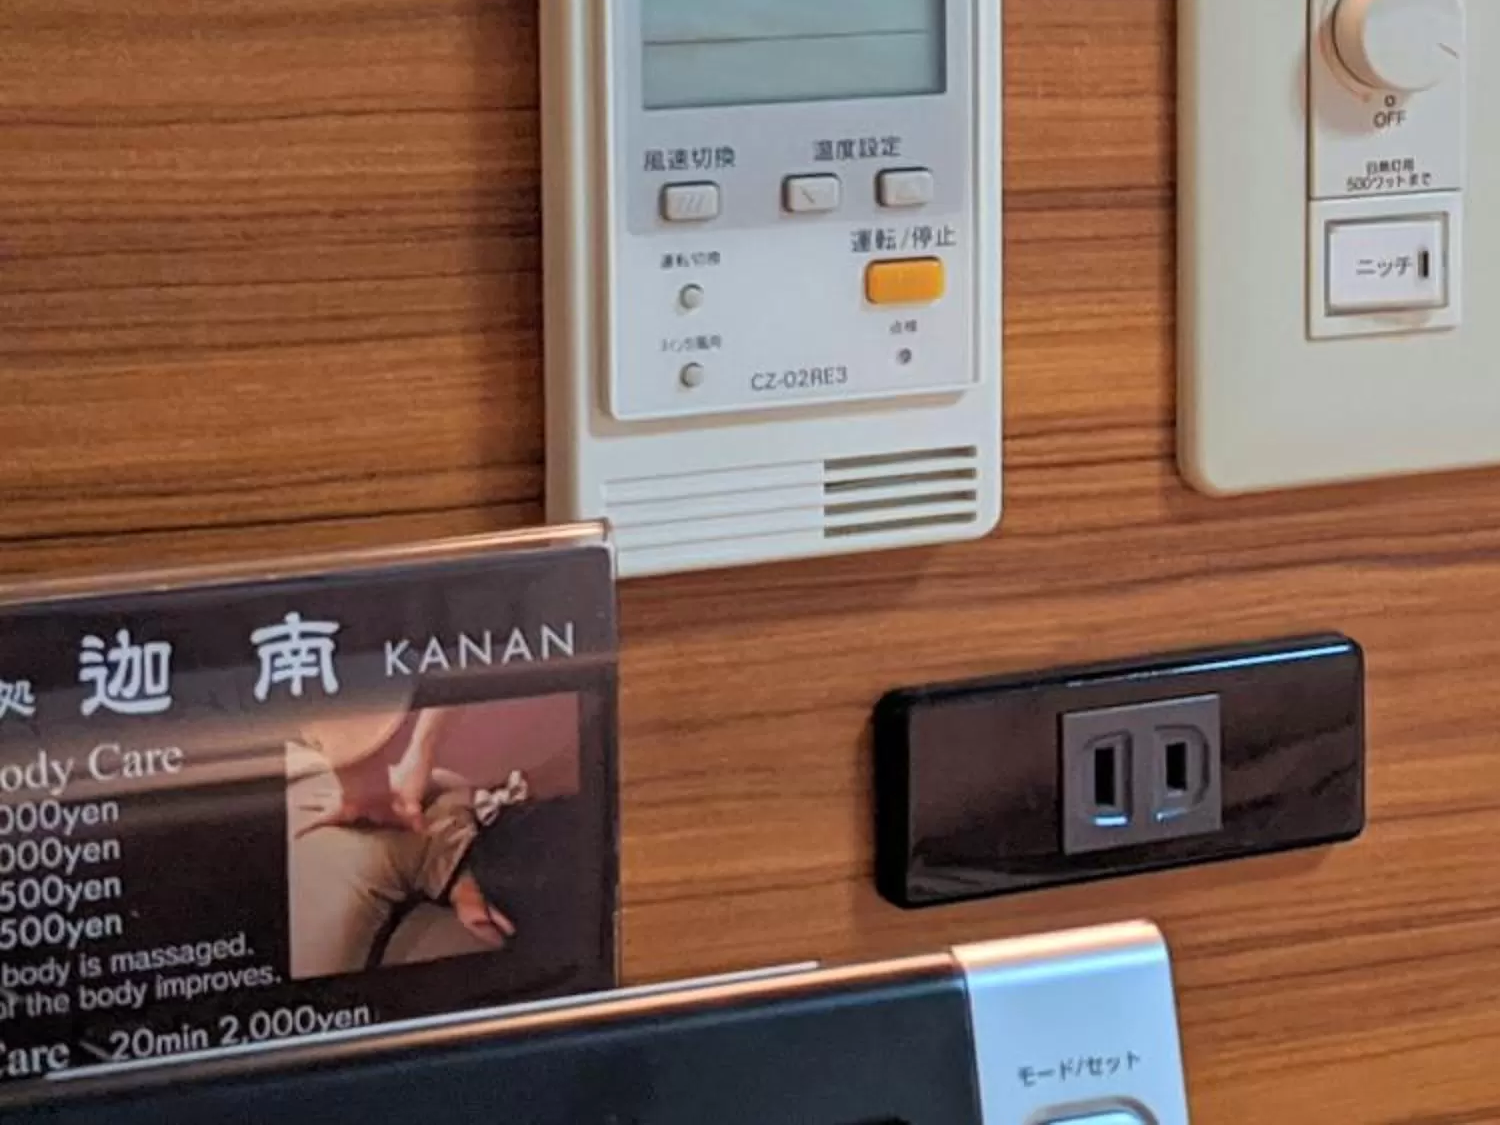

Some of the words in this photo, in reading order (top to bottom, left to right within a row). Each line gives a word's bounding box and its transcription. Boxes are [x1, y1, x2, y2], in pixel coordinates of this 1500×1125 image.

[1373, 109, 1408, 129] OFF
[643, 146, 736, 173] 風速切換
[812, 136, 902, 162] 温度設定
[851, 225, 957, 254] 運転/停止
[1355, 255, 1414, 278] ニッチ
[750, 365, 849, 392] CZ-02RE3
[79, 628, 173, 718] 迦
[249, 611, 340, 702] 南
[383, 621, 576, 678] KANAN
[0, 747, 75, 796] ody
[88, 742, 185, 782] Care
[0, 875, 122, 913] 500yen
[0, 912, 123, 950] 500yen
[1, 956, 71, 987] body
[79, 952, 103, 978] is
[110, 931, 255, 974] massaged.
[25, 989, 71, 1018] the
[79, 978, 149, 1011] body
[155, 964, 283, 1001] improves.
[0, 1040, 71, 1077] are
[109, 1022, 209, 1062] 20min
[1017, 1050, 1141, 1088] モード/セット
